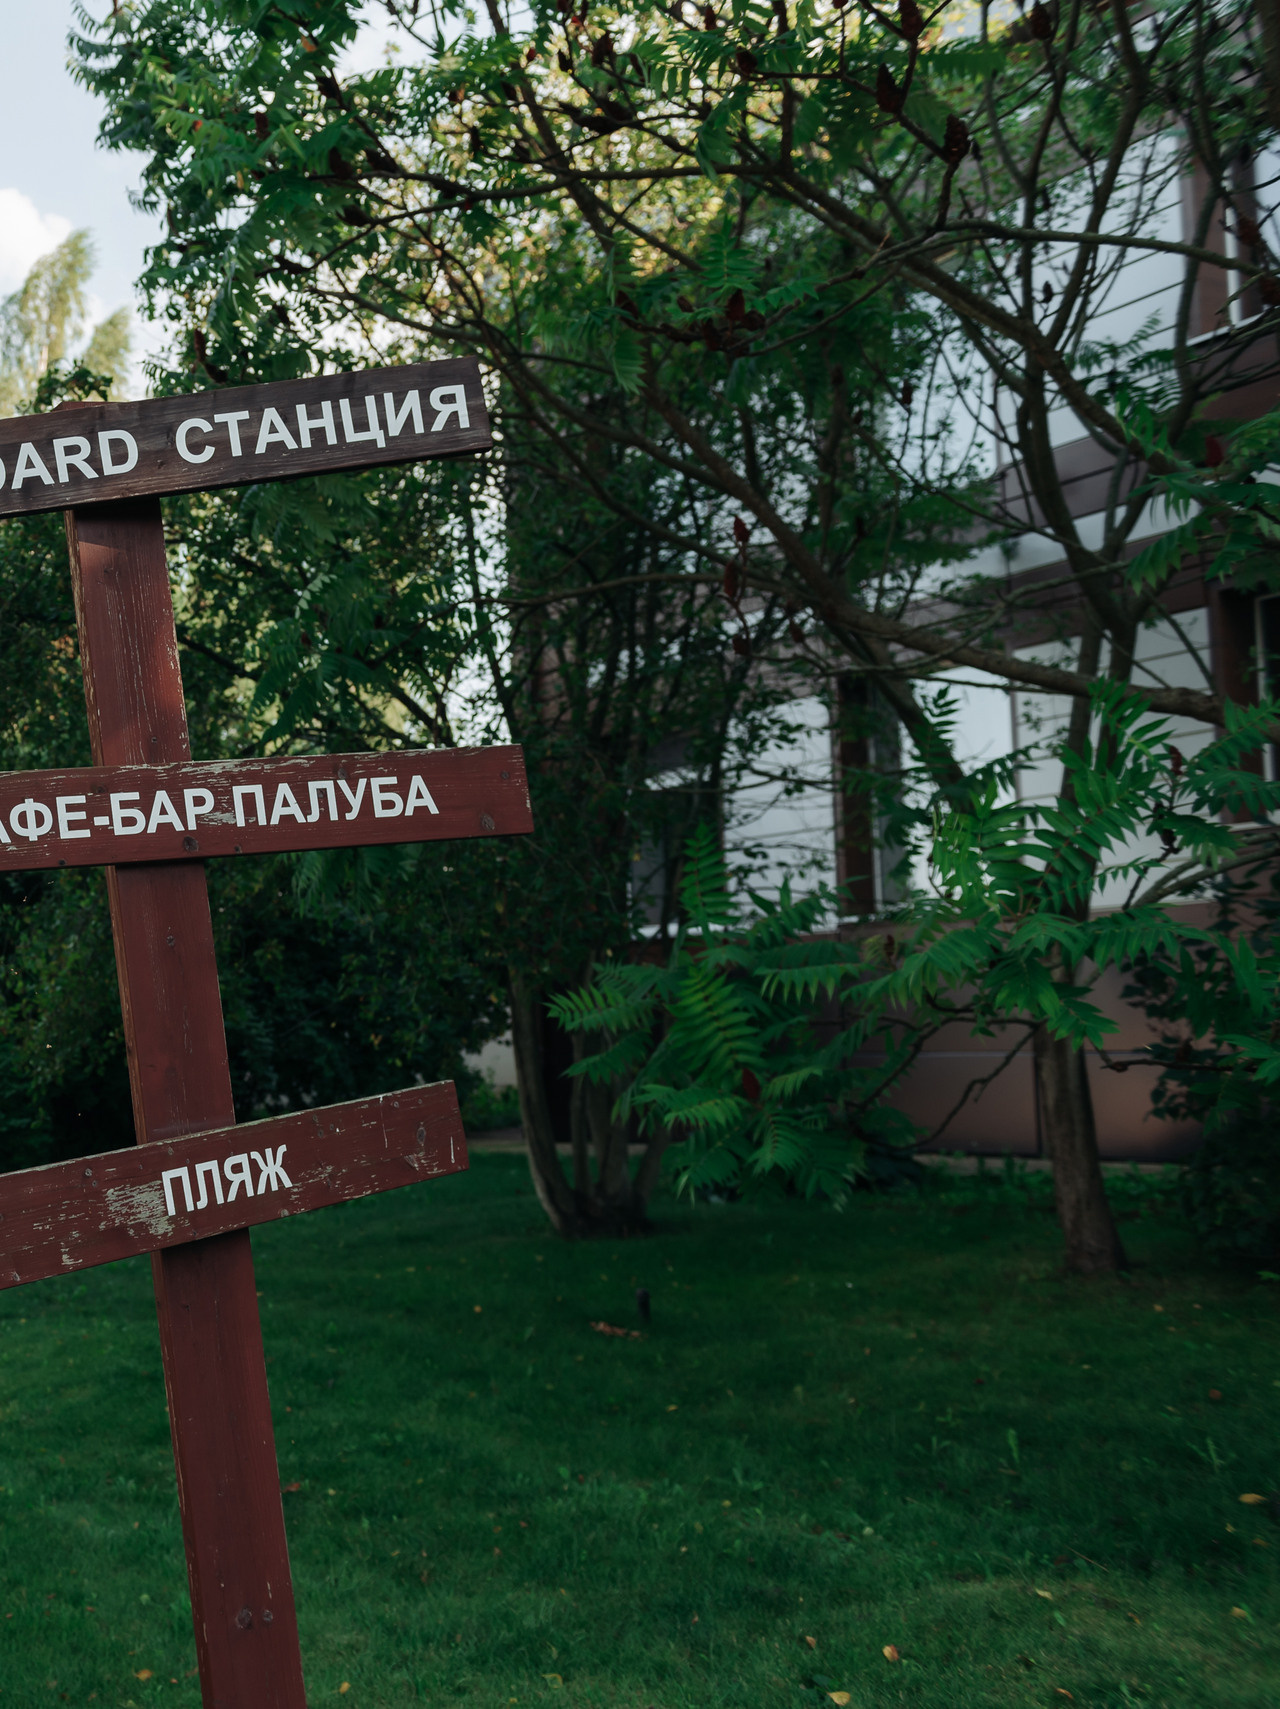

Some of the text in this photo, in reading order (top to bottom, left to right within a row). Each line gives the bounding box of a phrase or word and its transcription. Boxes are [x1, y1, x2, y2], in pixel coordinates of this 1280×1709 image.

[175, 384, 471, 464] СТАНЦИЯ
[232, 774, 440, 828] ПАЛУБА
[161, 1144, 293, 1217] ПЛЯЖ
